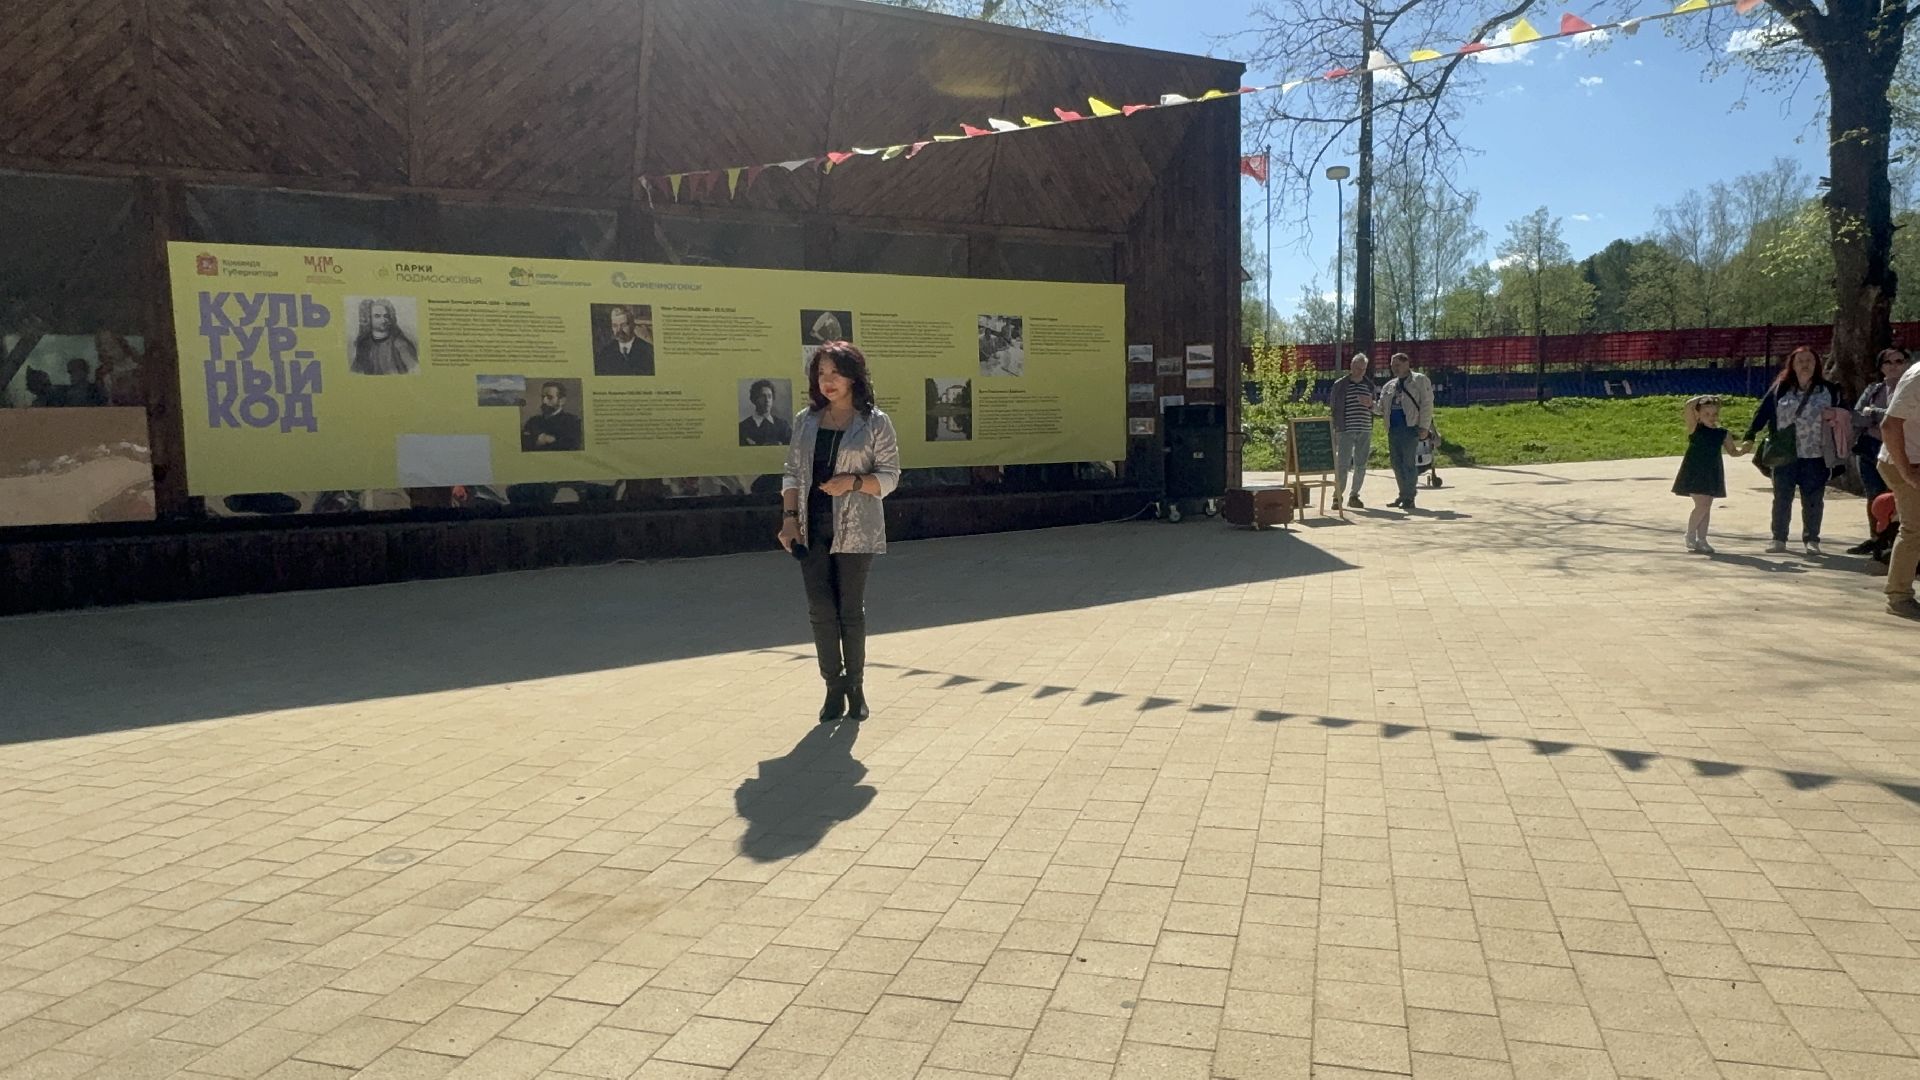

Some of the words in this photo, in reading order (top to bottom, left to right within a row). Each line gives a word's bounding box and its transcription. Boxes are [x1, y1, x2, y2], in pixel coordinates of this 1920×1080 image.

[222, 259, 261, 268] Команда
[222, 268, 279, 278] Губернатора
[395, 263, 433, 273] ПАРКИ
[396, 273, 482, 284] ПОДМОСКОВЬЯ
[198, 292, 331, 328] КУЛЬ
[199, 326, 297, 361] ТУР
[204, 351, 323, 395] НЫЙ
[207, 392, 318, 433] КОД
